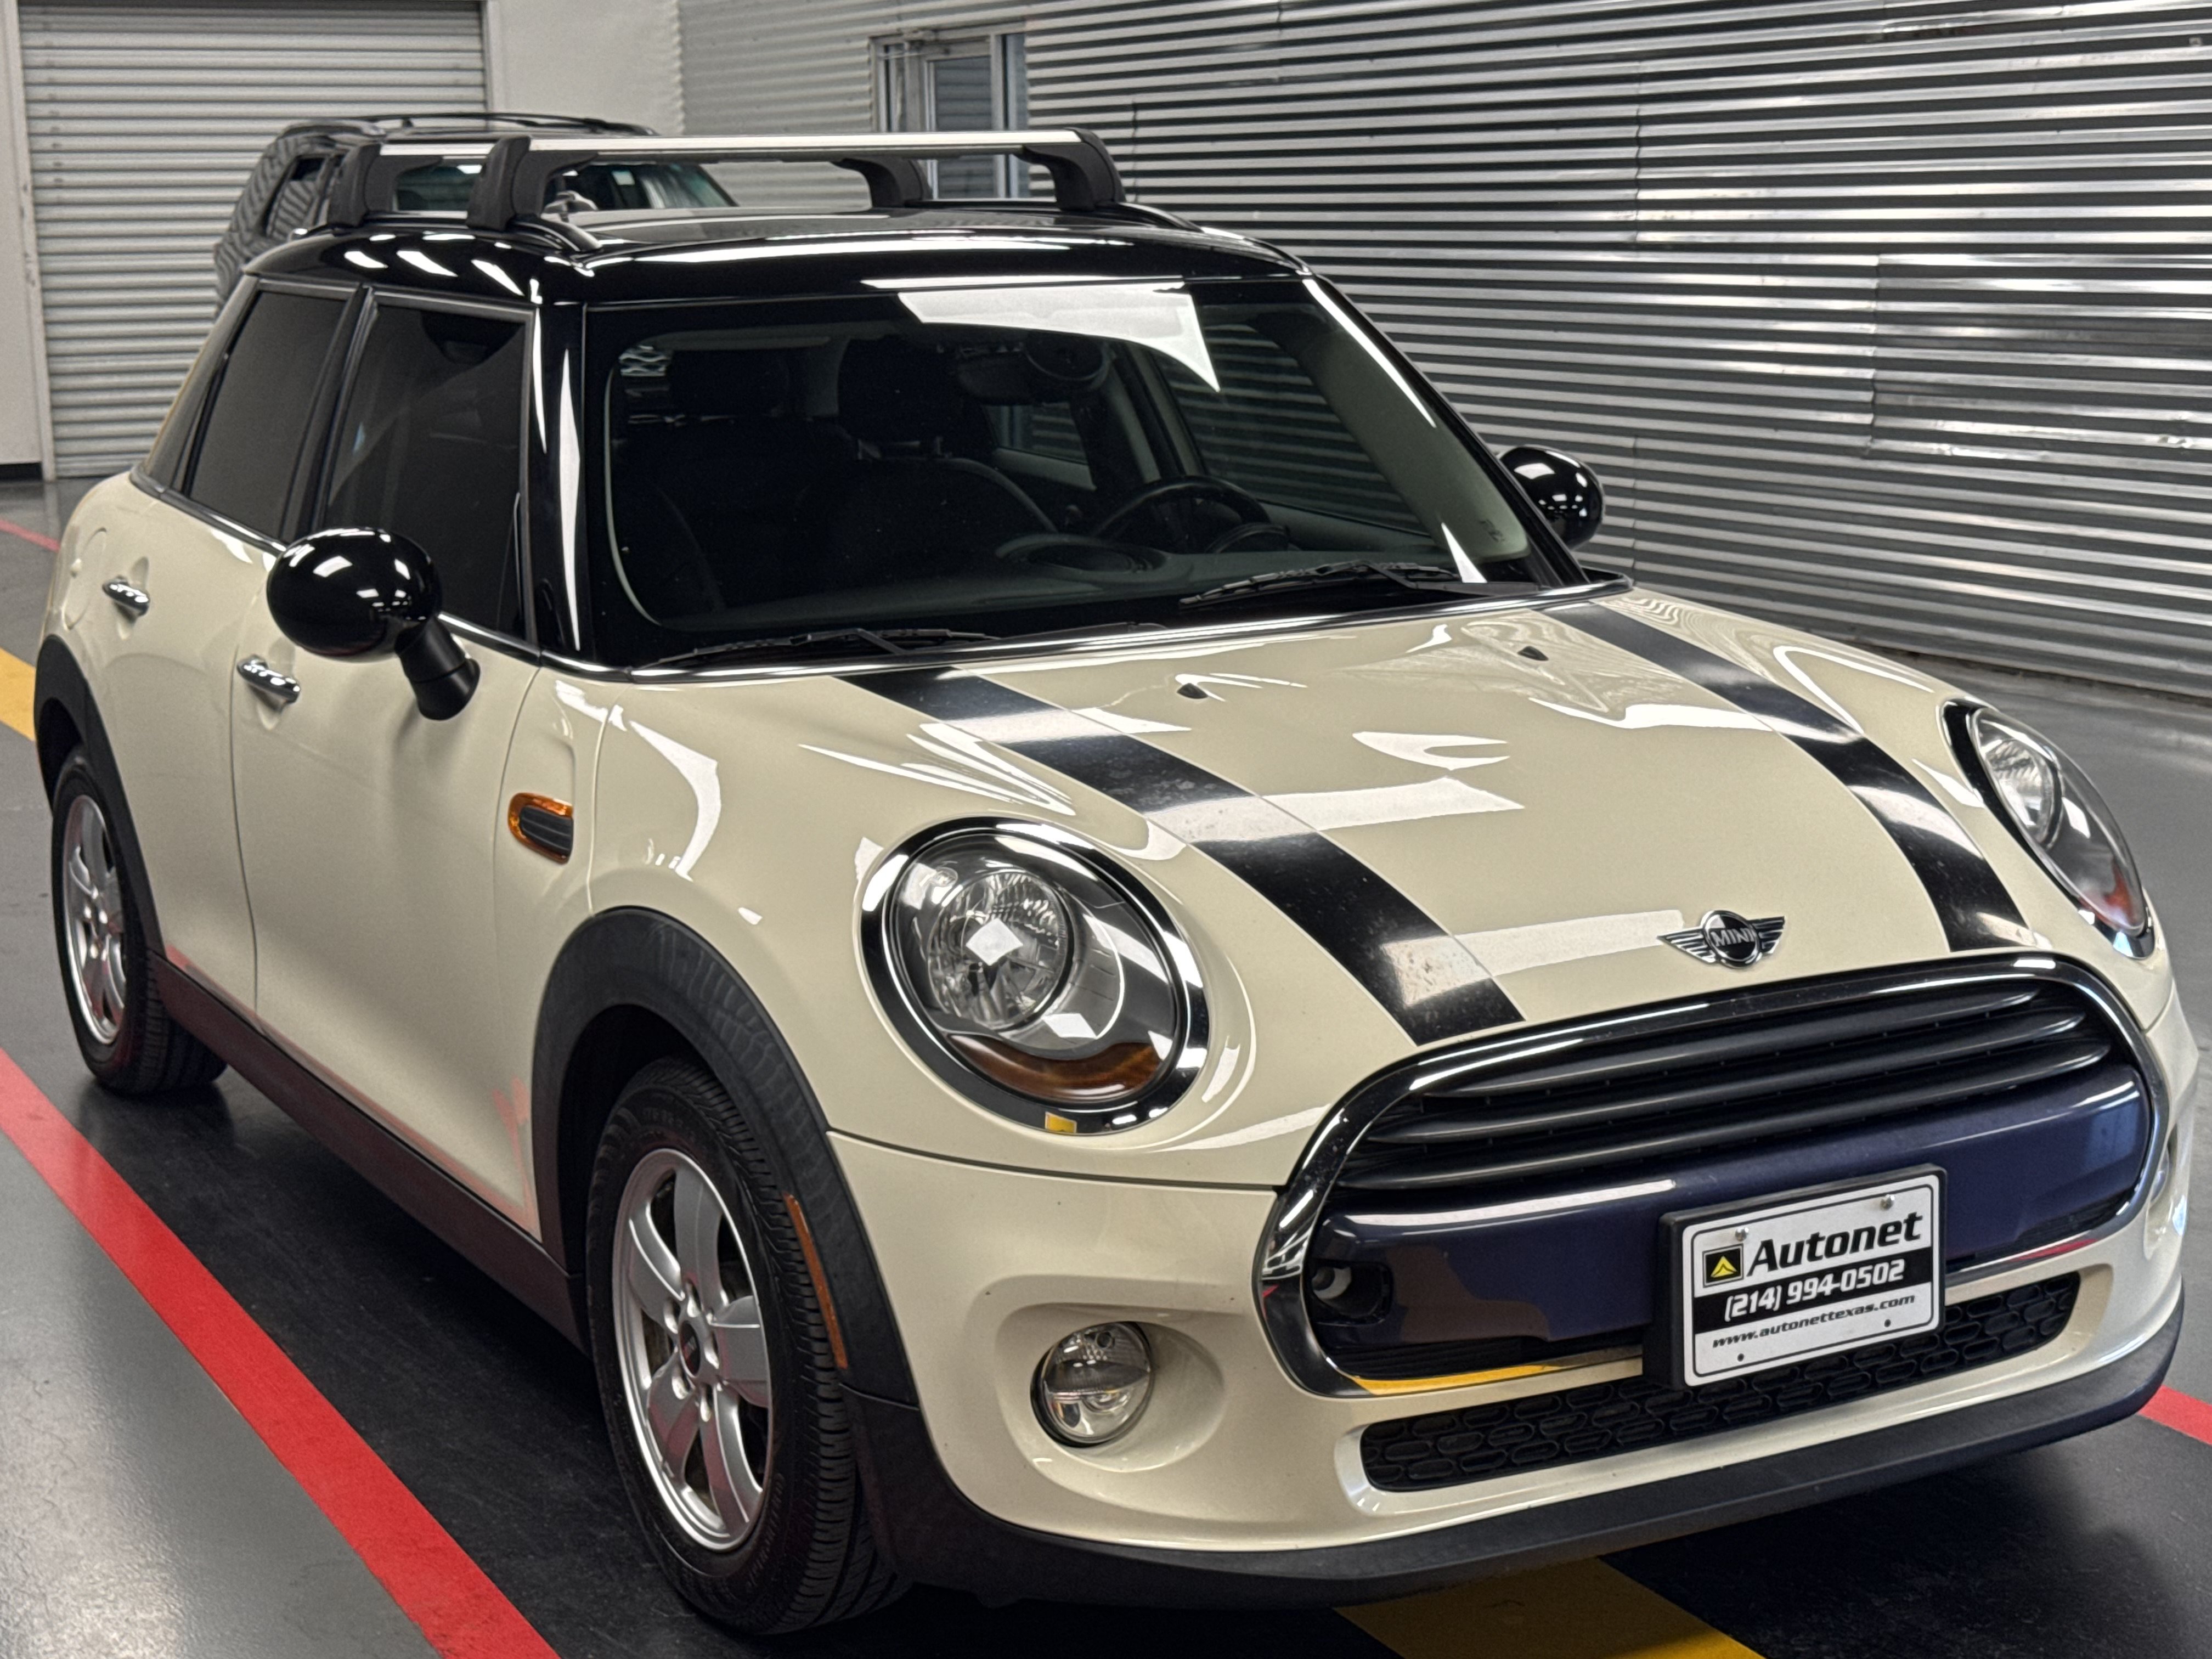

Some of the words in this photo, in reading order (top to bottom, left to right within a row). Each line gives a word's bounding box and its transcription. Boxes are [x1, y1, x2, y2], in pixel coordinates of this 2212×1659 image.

[1711, 927, 1756, 947] MINI
[1747, 1212, 1923, 1277] Autonet
[1724, 1286, 1782, 1322] (214)
[1786, 1259, 1905, 1305] 994-0502
[1712, 1294, 1915, 1348] www.autonettexas.com
